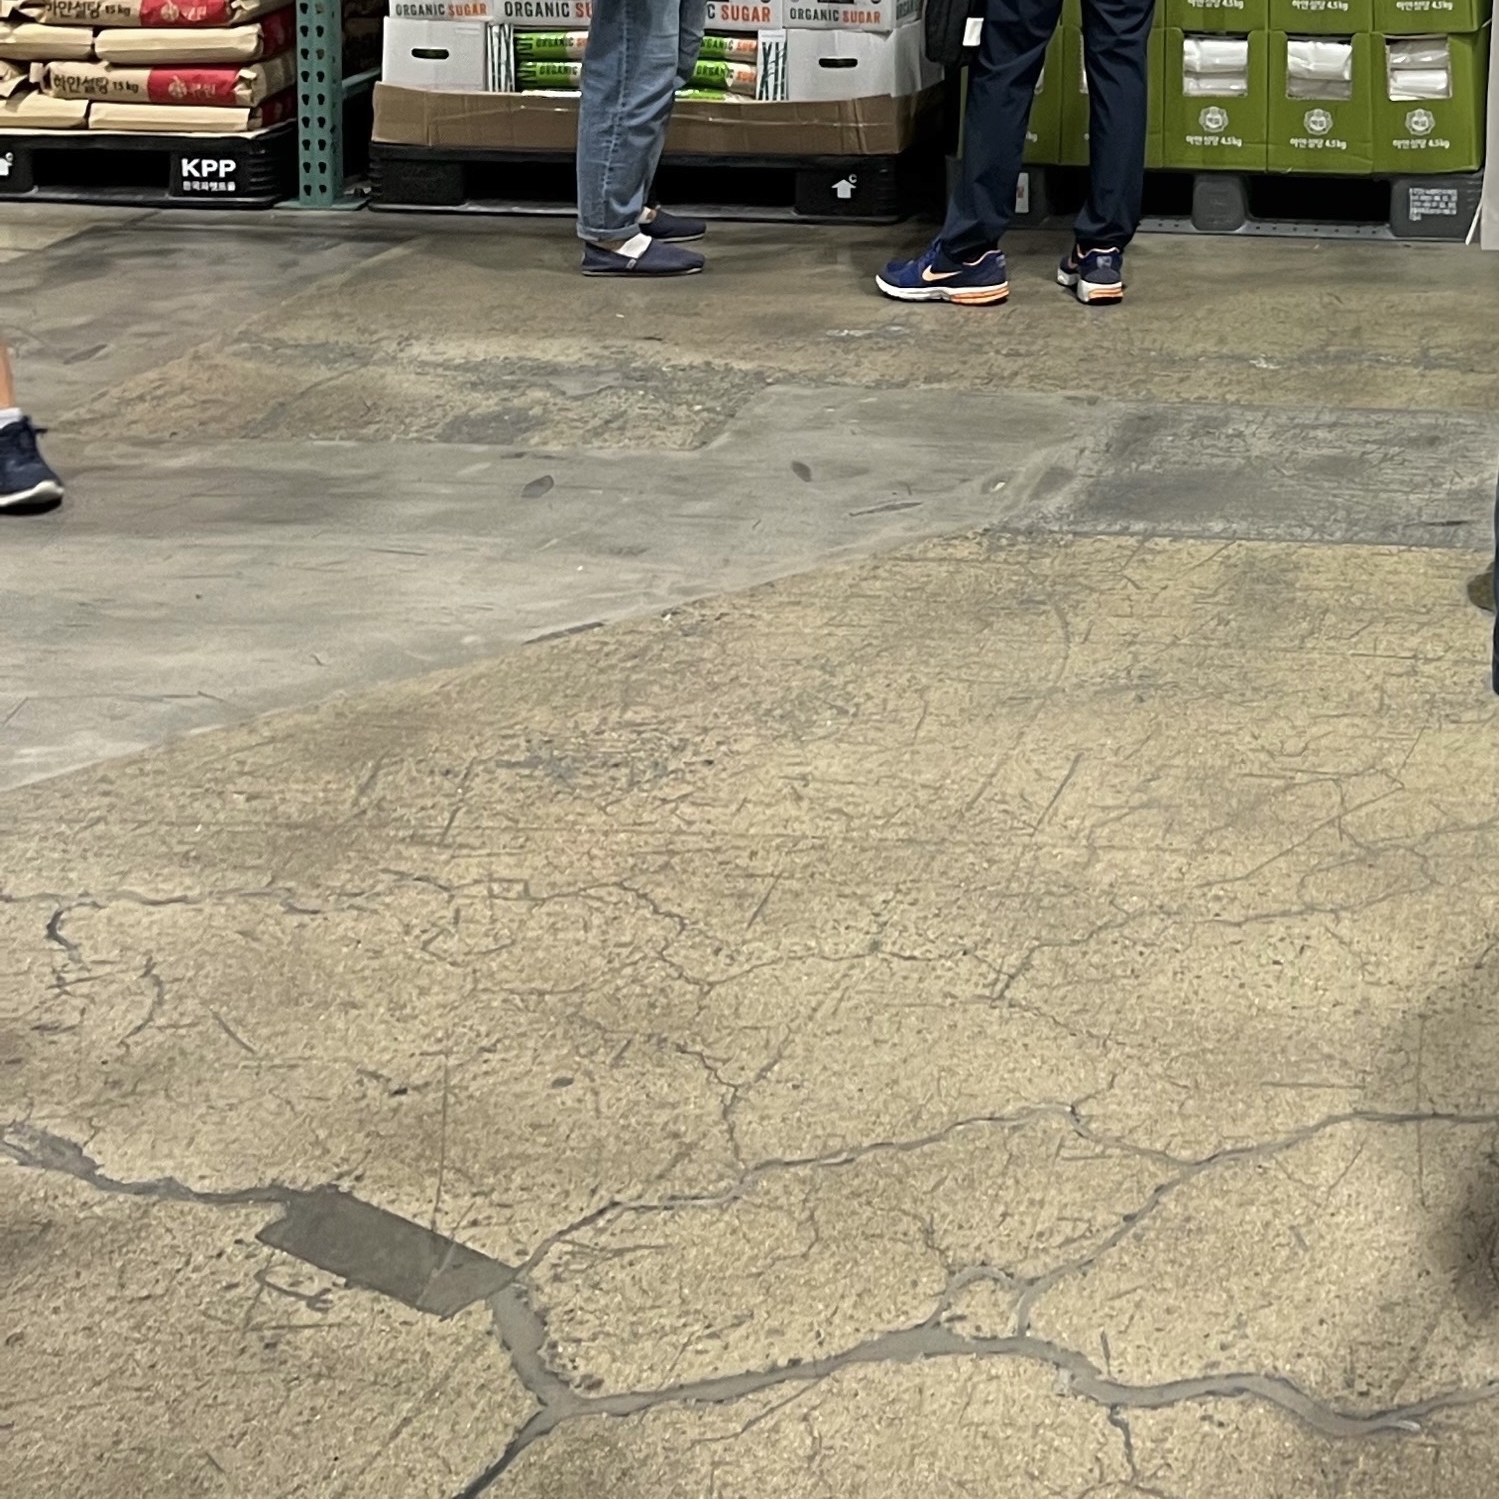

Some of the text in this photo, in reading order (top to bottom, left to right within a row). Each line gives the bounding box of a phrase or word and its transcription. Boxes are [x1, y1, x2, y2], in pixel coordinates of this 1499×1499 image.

[396, 3, 487, 17] ORGANIC SUGAR
[504, 1, 570, 17] ORGANIC
[1327, 1, 1349, 12] 4.5kg
[1431, 1, 1453, 11] 4.5kg
[721, 5, 771, 22] SUGAR
[790, 7, 881, 24] ORGANIC SUGAR
[1221, 137, 1242, 148] 4.5kg
[1325, 139, 1347, 150] 4.5kg
[1428, 139, 1450, 150] 4.5kg
[181, 158, 236, 178] KPP
